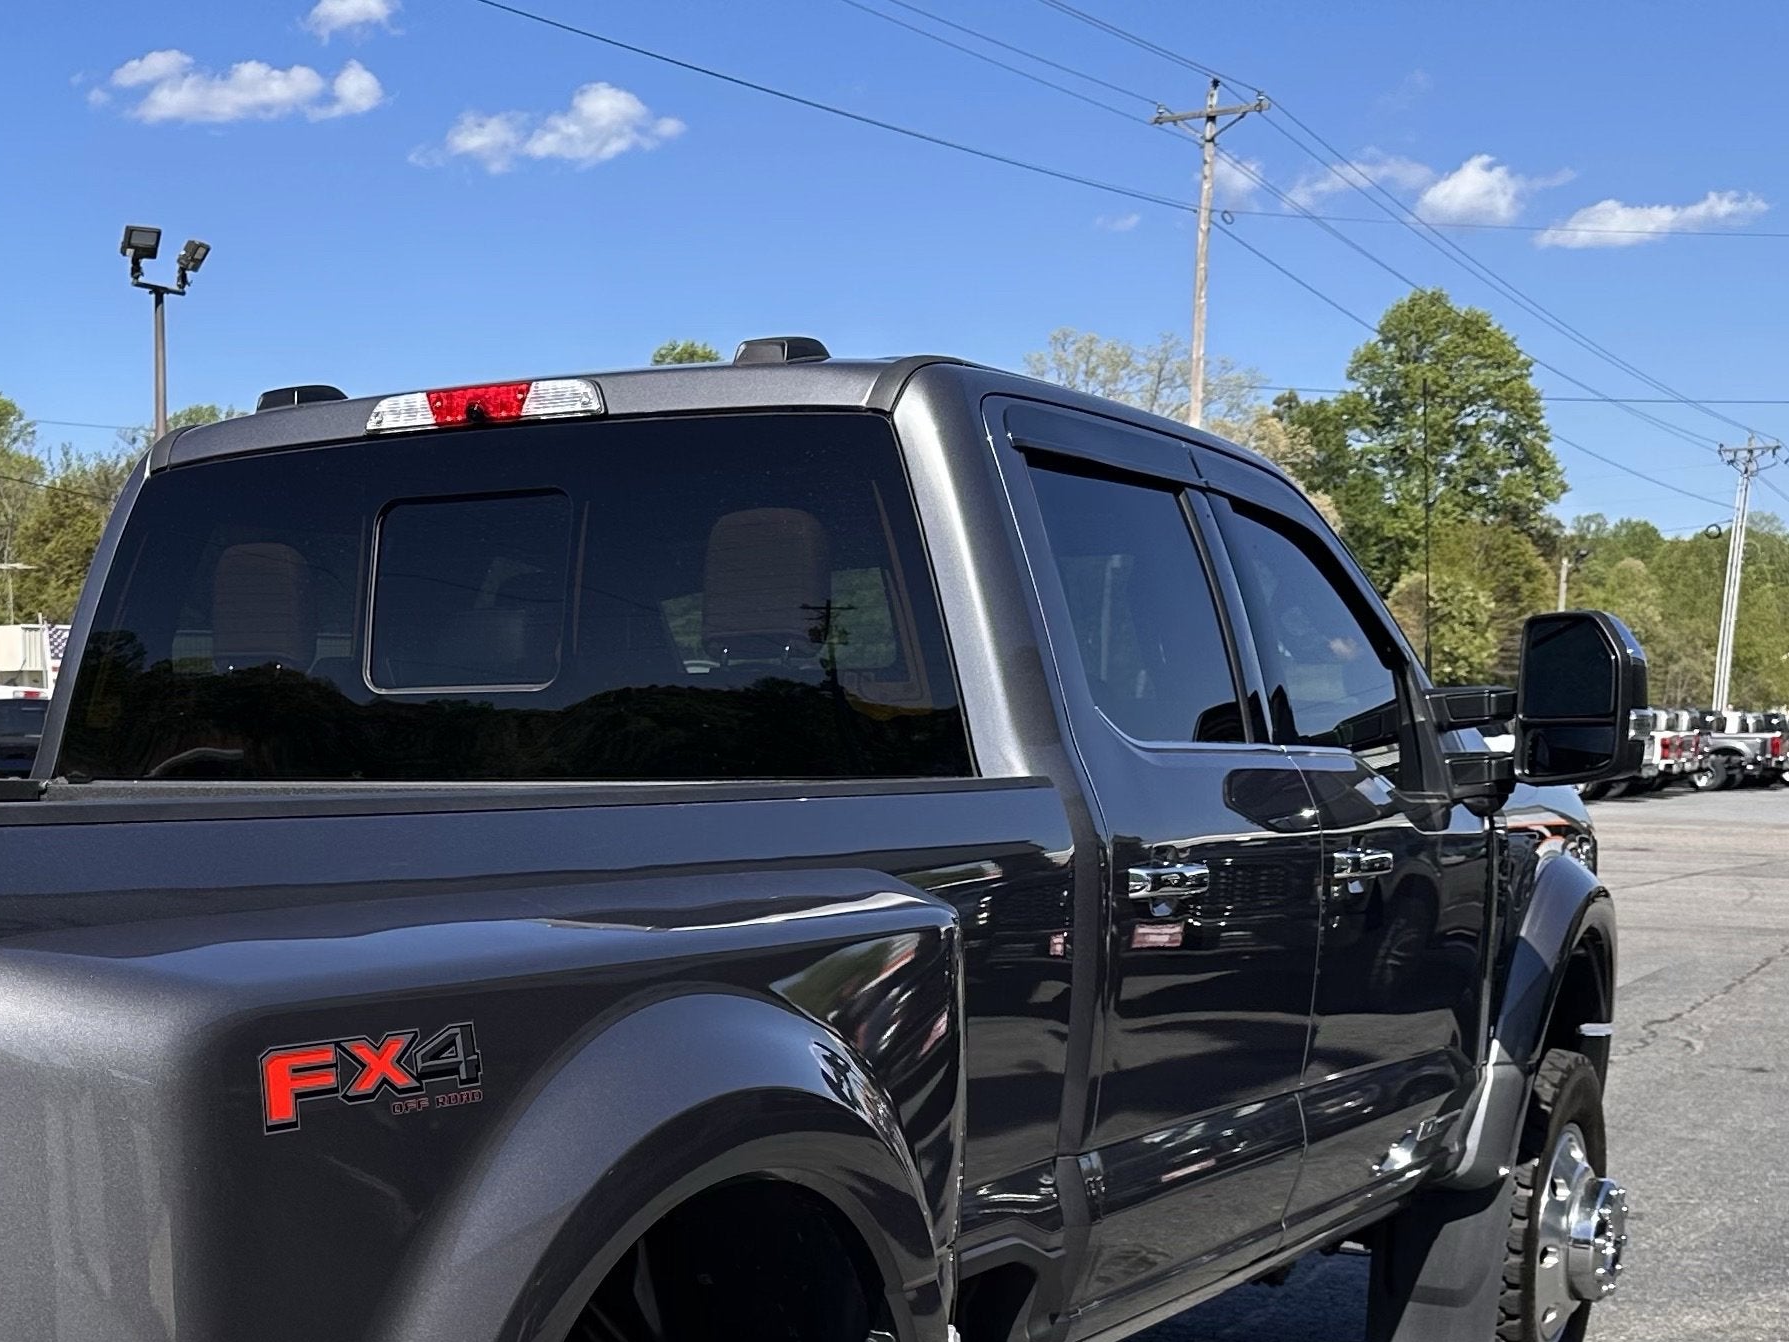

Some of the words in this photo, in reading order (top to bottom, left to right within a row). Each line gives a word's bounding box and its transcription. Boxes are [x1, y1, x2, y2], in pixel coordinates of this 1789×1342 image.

[259, 1019, 483, 1136] FX4
[391, 1097, 429, 1115] OFF
[435, 1089, 484, 1109] ROAD
